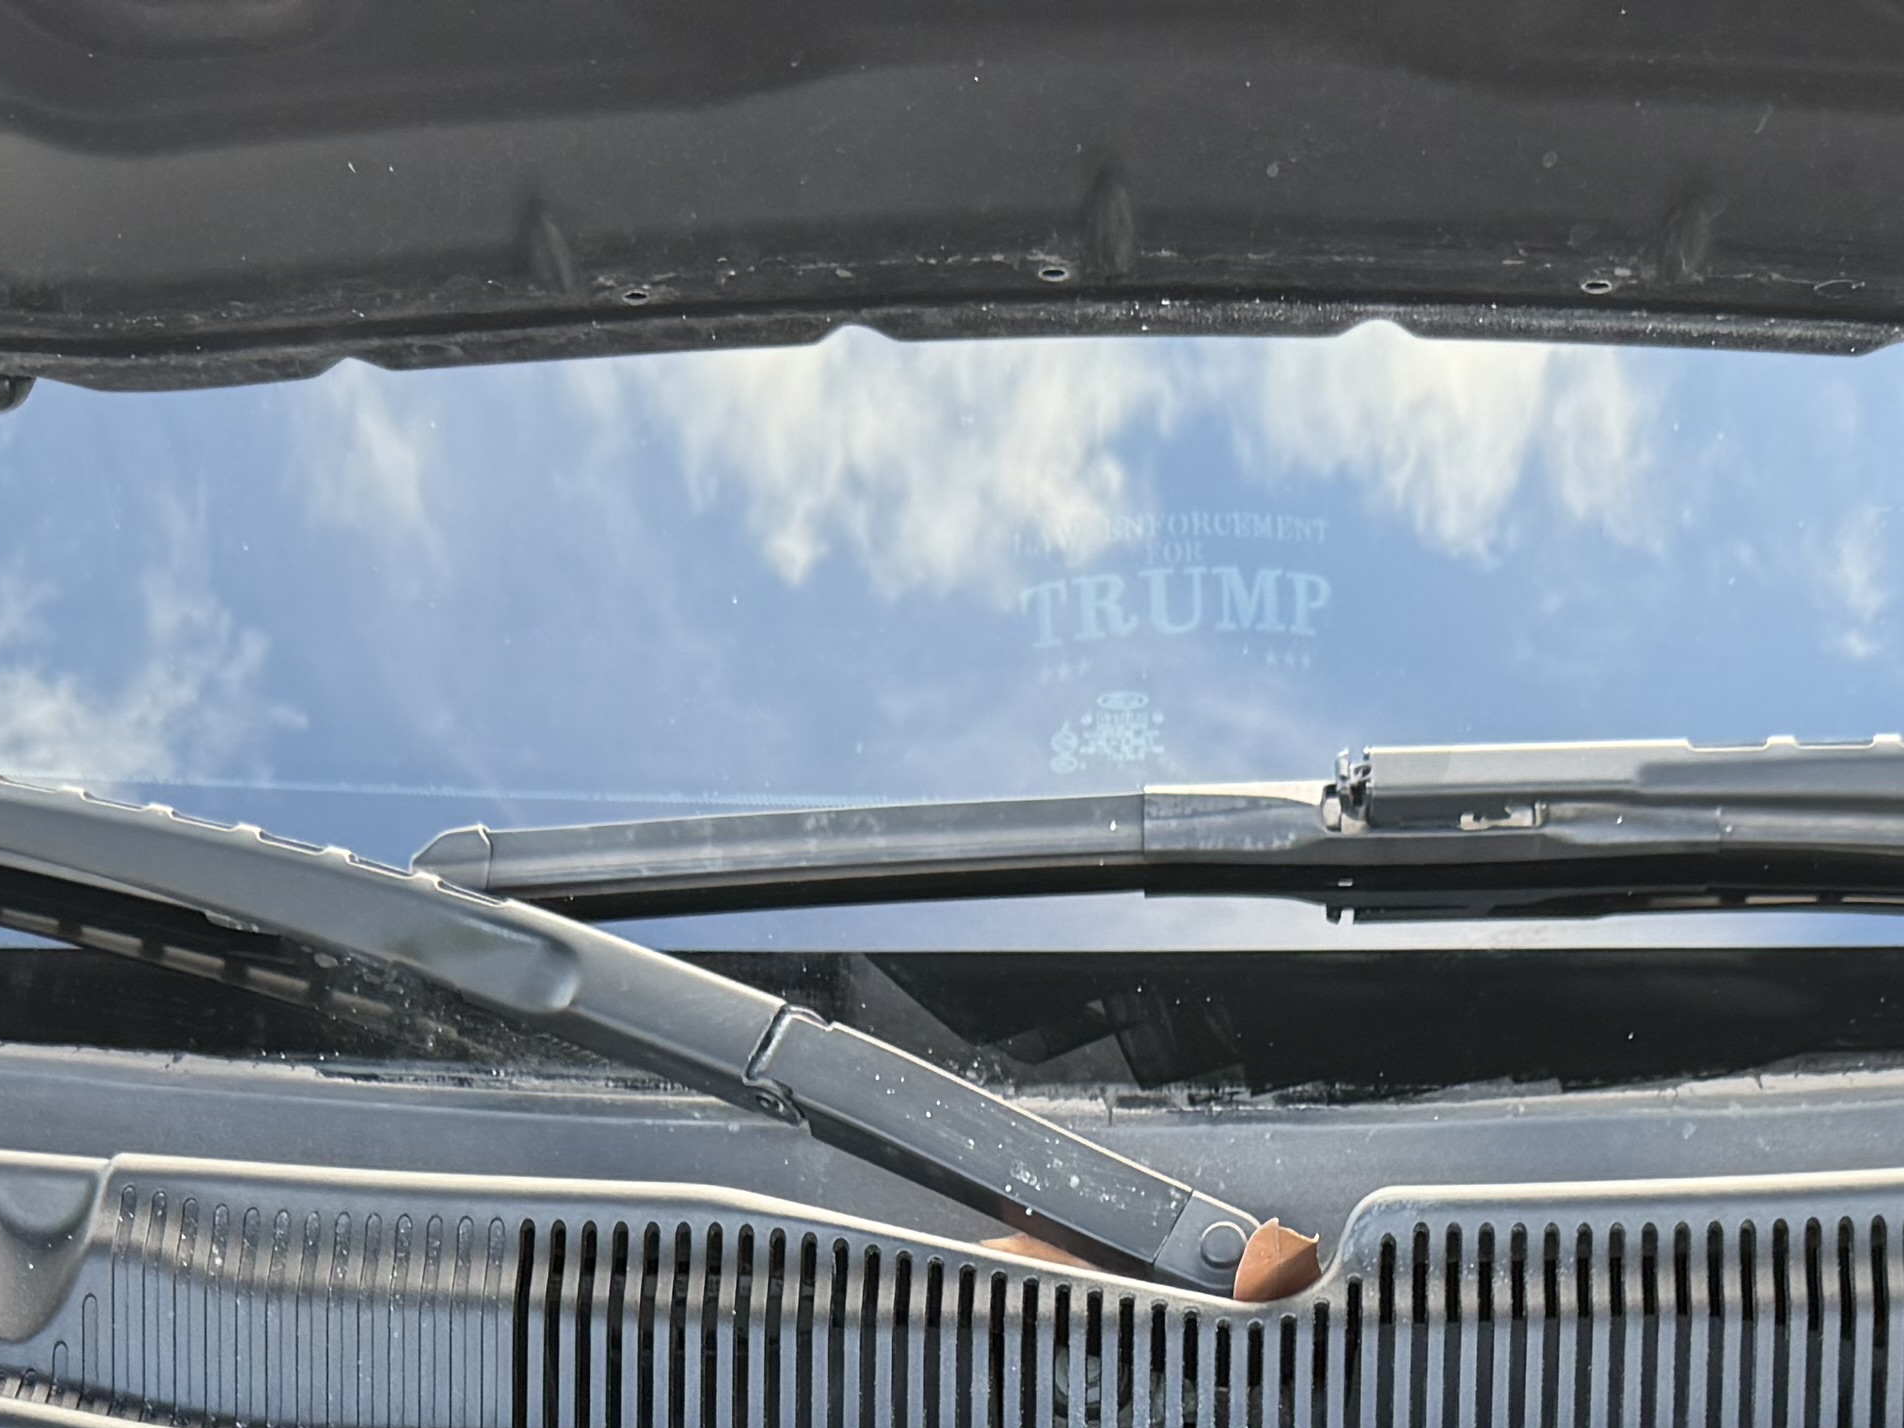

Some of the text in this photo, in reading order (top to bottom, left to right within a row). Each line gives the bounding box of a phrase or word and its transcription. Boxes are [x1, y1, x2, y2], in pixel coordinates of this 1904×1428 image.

[1102, 511, 1329, 544] ENFORCEMENT
[1144, 540, 1203, 565] FOR
[1019, 565, 1332, 650] TRUMP
